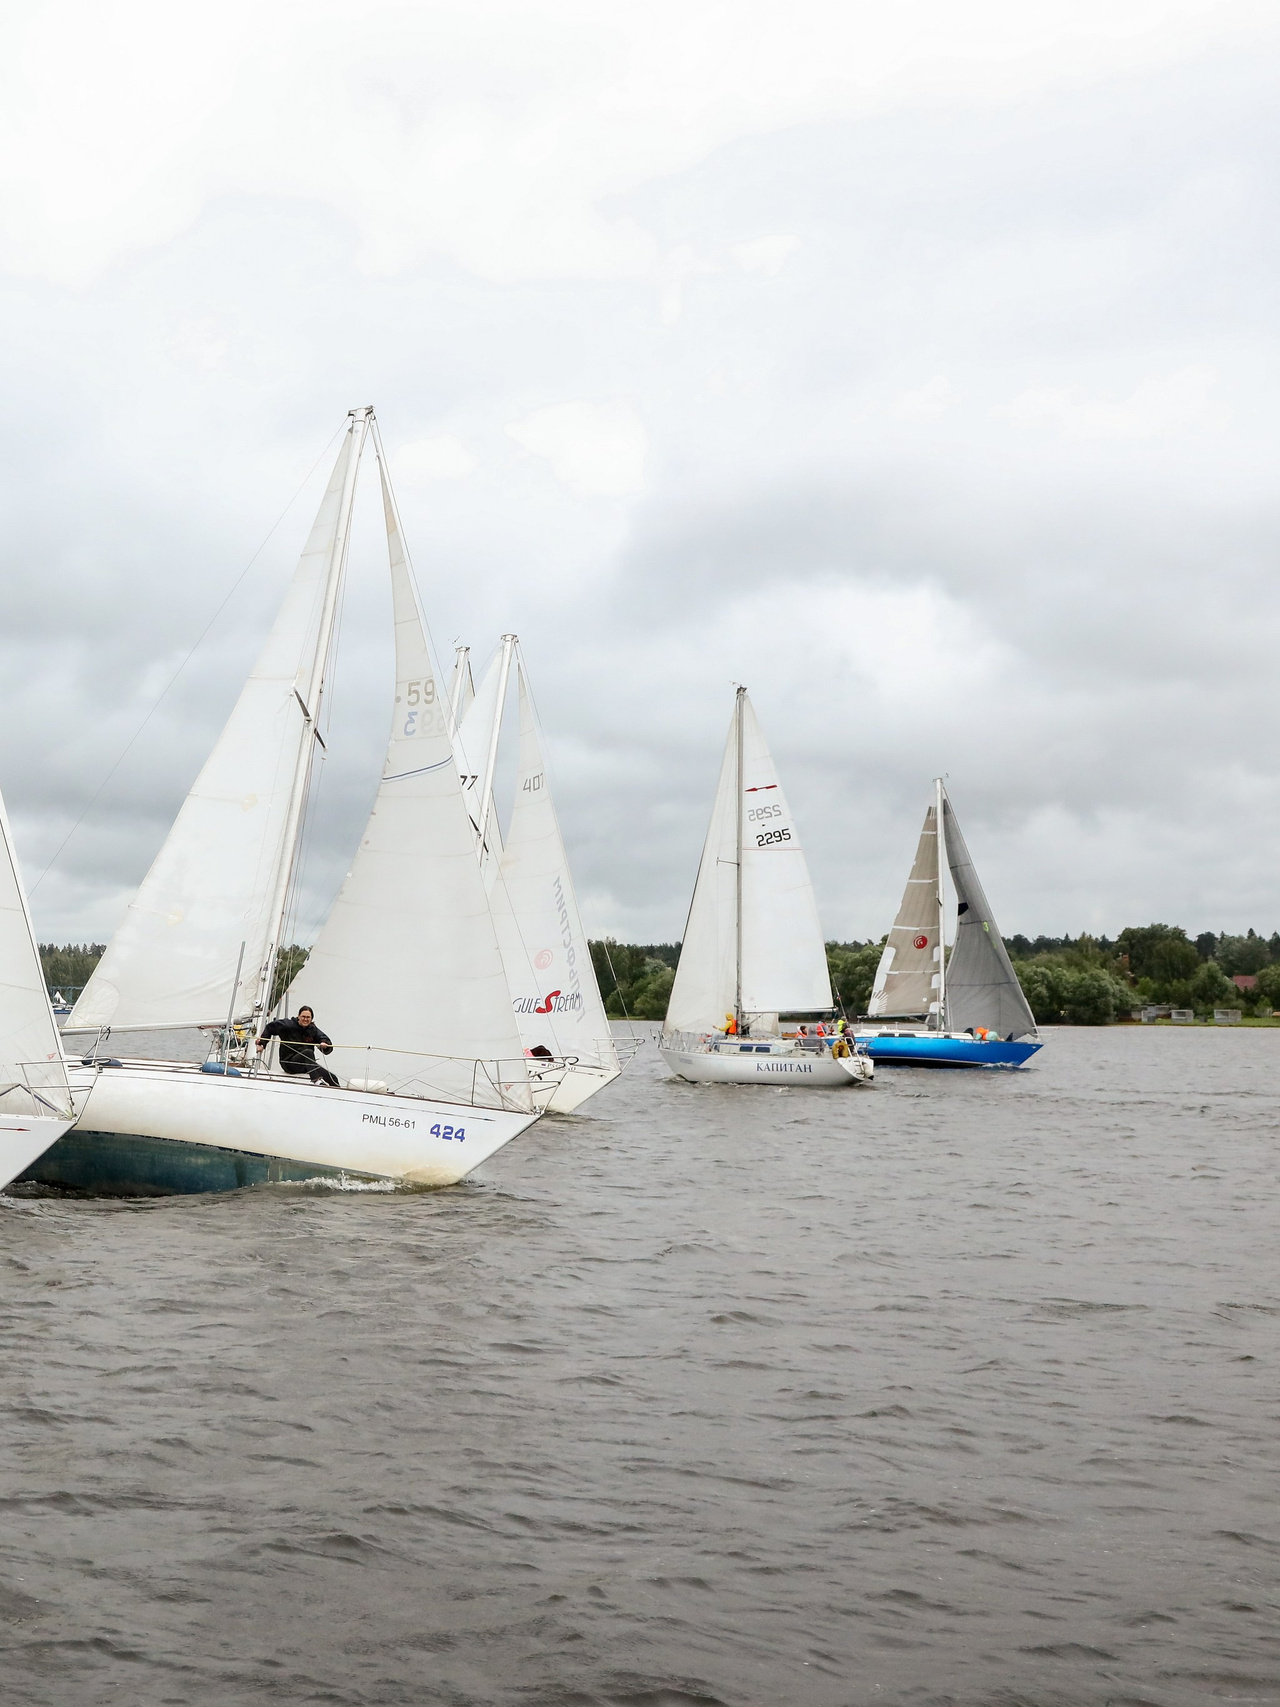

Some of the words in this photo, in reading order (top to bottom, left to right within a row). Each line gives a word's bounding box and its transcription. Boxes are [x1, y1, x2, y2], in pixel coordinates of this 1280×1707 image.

[756, 828, 791, 847] 2295
[756, 1062, 813, 1073] КАПИТАН
[362, 1113, 387, 1128] РМЦ
[388, 1117, 416, 1129] 56-61
[430, 1123, 466, 1142] 424
